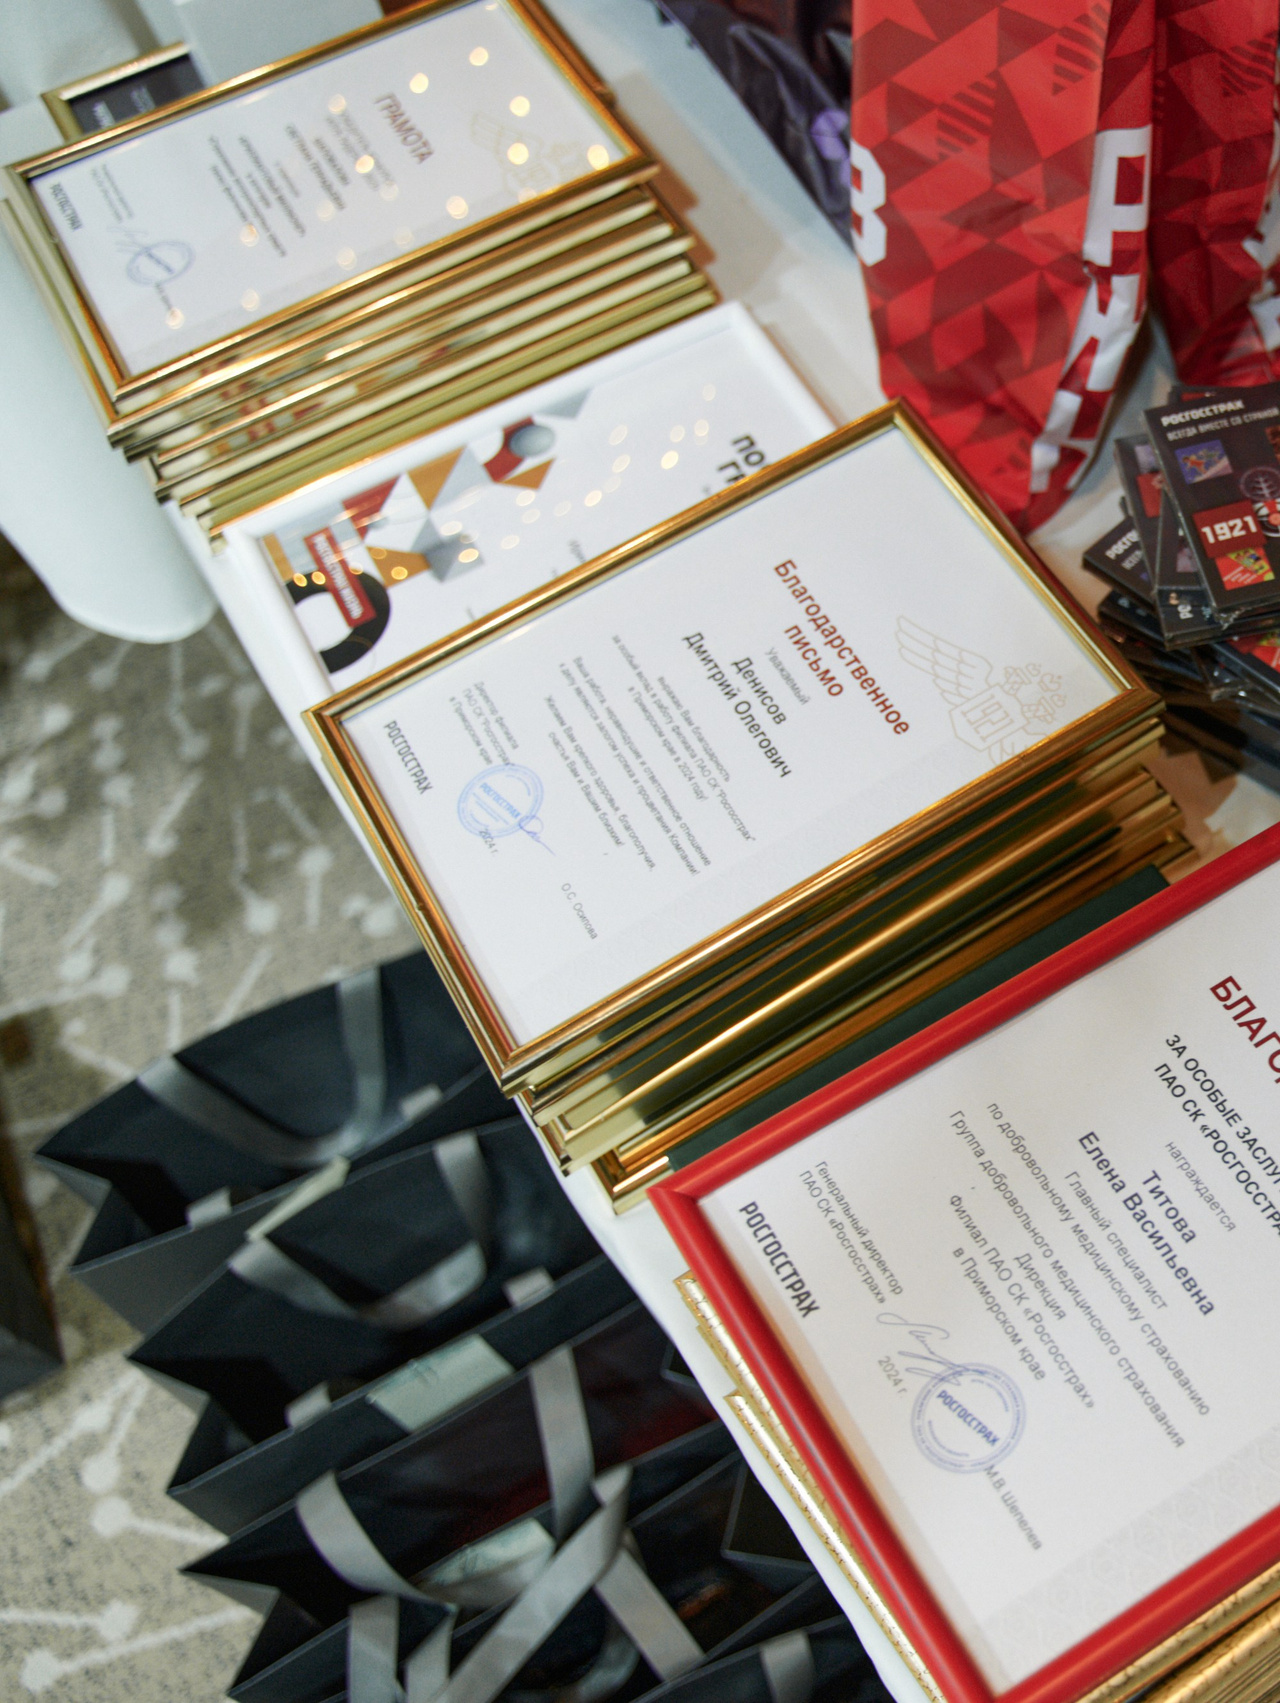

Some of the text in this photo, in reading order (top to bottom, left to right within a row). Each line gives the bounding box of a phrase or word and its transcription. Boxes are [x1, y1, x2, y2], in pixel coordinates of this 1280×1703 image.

[376, 93, 434, 164] ГРАМОТА
[1160, 399, 1245, 427] РОСГОССТРАХ
[1201, 515, 1258, 544] 1921
[764, 647, 811, 706] Уважаемый
[773, 559, 910, 735] Благодарственное
[784, 624, 844, 697] письмо
[682, 632, 792, 778] Дмитрий Олегович
[730, 656, 787, 725] Денисов
[960, 693, 1015, 743] 1921
[383, 719, 433, 795] РОСГОССТРАХ
[1154, 1063, 1187, 1098] ПАО
[1182, 1099, 1206, 1123] СК
[1165, 1034, 1188, 1059] ЗА
[1183, 1057, 1243, 1128] ОСОБЫЕ
[1078, 1131, 1215, 1316] Елена Васильевна
[1142, 1169, 1197, 1244] Титова
[1164, 1141, 1237, 1232] награждается
[738, 1200, 820, 1318] РОСГОССТРАХ
[799, 1169, 886, 1304] ПАО СК «Росгосстрах»
[815, 1160, 904, 1296] Генеральный директор
[986, 1102, 1210, 1416] по добровольному медицинскому страхованию
[1064, 1170, 1168, 1309] Главный специалист
[949, 1110, 1185, 1448] Группа добровольного медицинского страхования
[949, 1194, 1095, 1409] Филиал ПАО СК «Росгосстрах»
[1012, 1252, 1067, 1321] Дирекция
[960, 1256, 1023, 1346] Приморском
[1018, 1346, 1046, 1381] крае
[876, 1354, 904, 1388] 2024
[935, 1388, 999, 1447] РОСГОССТРАХ
[999, 1489, 1045, 1551] Шепелев
